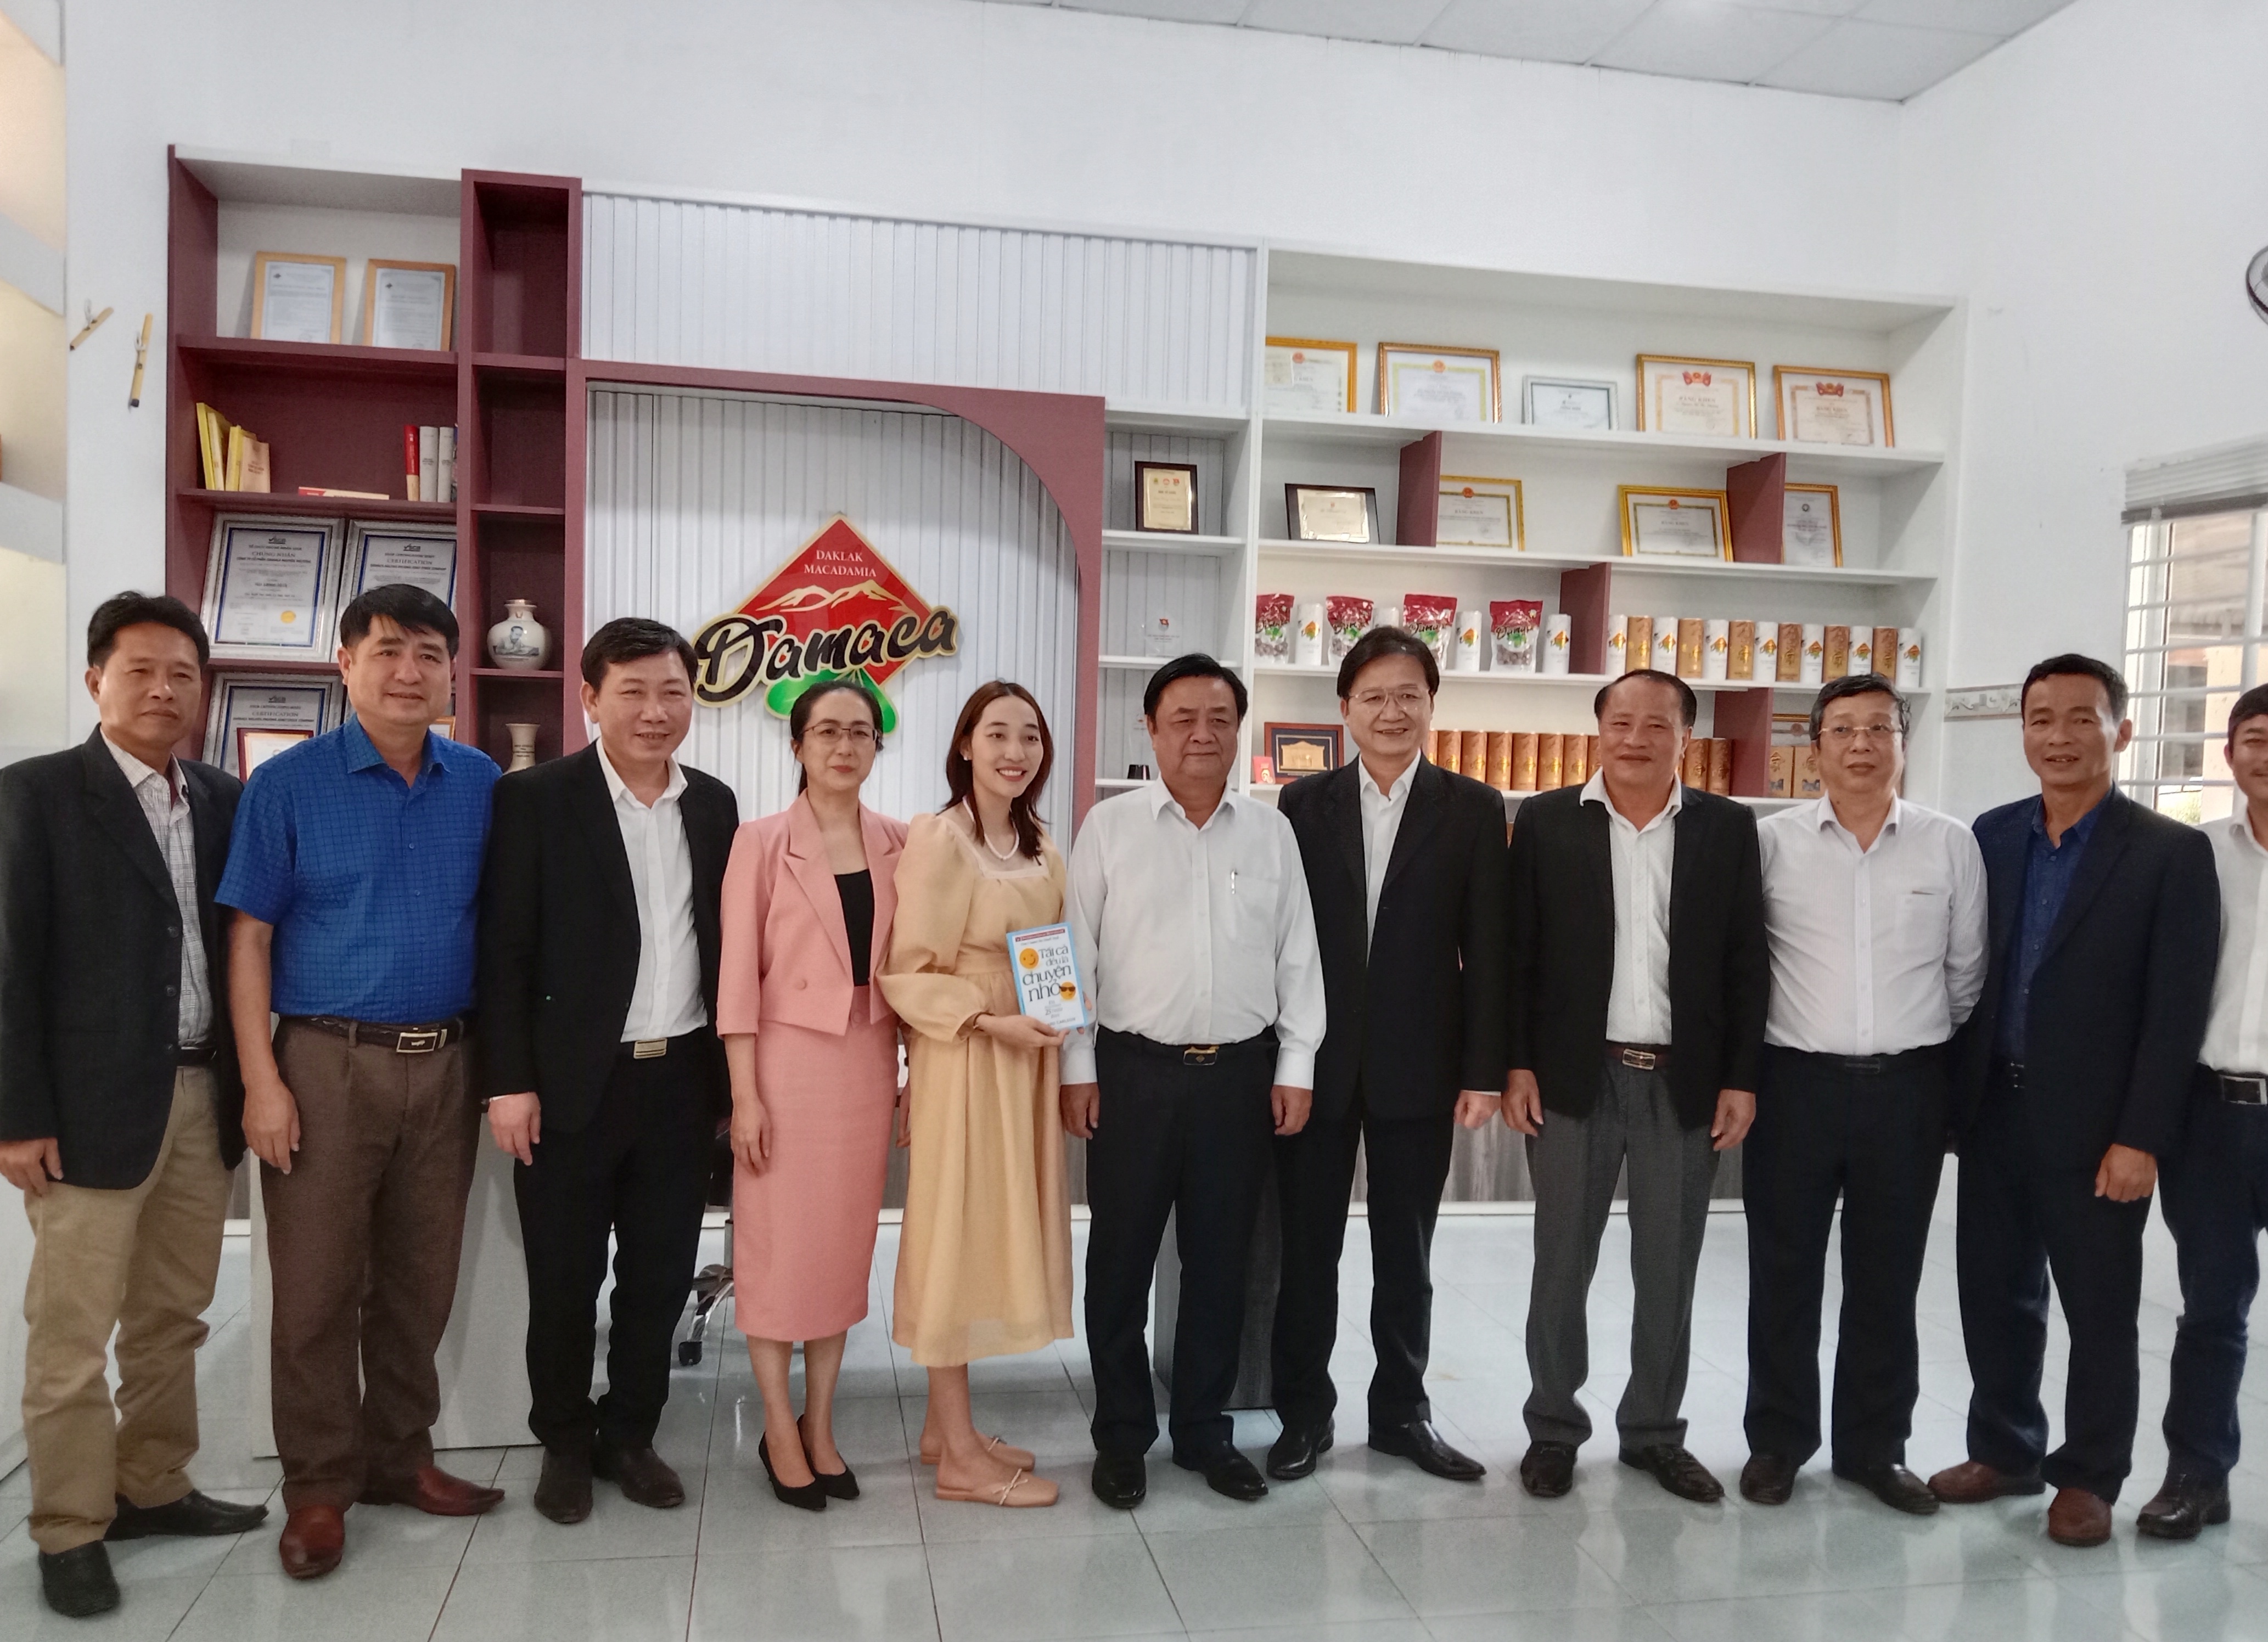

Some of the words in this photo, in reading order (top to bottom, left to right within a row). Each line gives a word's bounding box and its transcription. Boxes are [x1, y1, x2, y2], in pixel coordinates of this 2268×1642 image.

[816, 550, 862, 562] DAKLAK
[804, 564, 876, 577] MACADAMIA
[1038, 947, 1054, 959] Tất
[1056, 944, 1069, 955] cả
[1023, 965, 1071, 986] chuyện
[1029, 979, 1060, 1002] nhỏ
